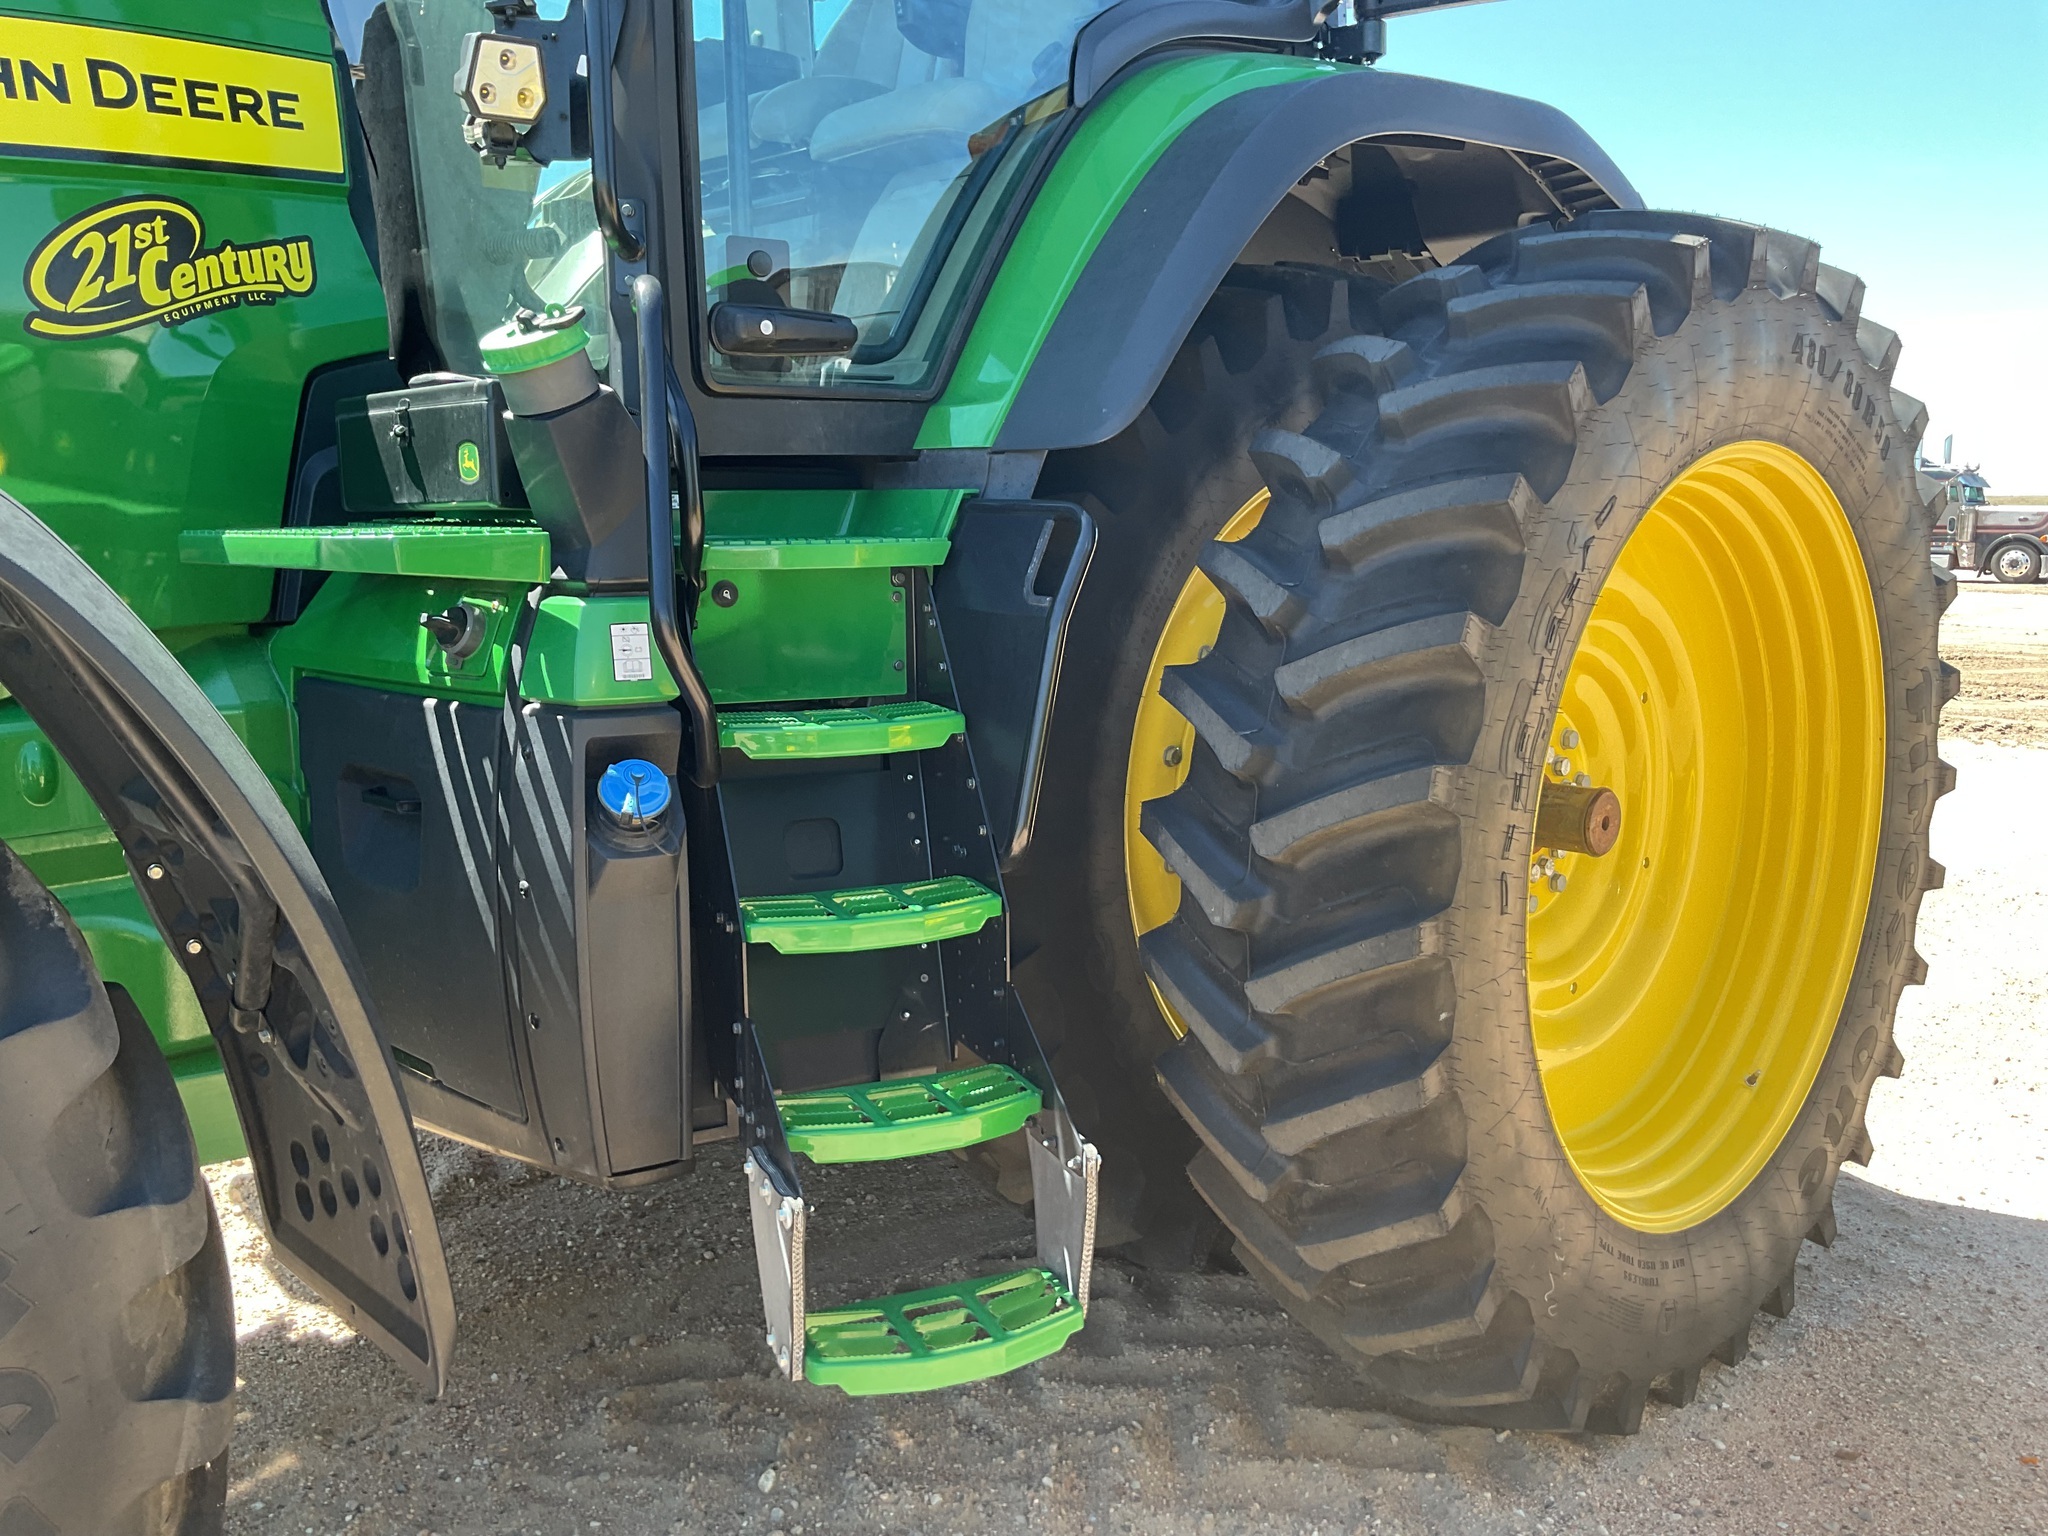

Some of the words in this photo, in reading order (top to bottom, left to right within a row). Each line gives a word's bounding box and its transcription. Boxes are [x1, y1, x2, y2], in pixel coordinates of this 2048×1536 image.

[86, 58, 305, 131] DEERE
[66, 215, 170, 312] 21st
[163, 294, 238, 323] EQUIPMENT
[1799, 665, 1932, 1197] Firestone
[1599, 1237, 1613, 1256] TYPE
[1617, 1250, 1634, 1266] TUBE
[1637, 1259, 1656, 1270] USED
[1623, 1270, 1659, 1287] TUBELESS
